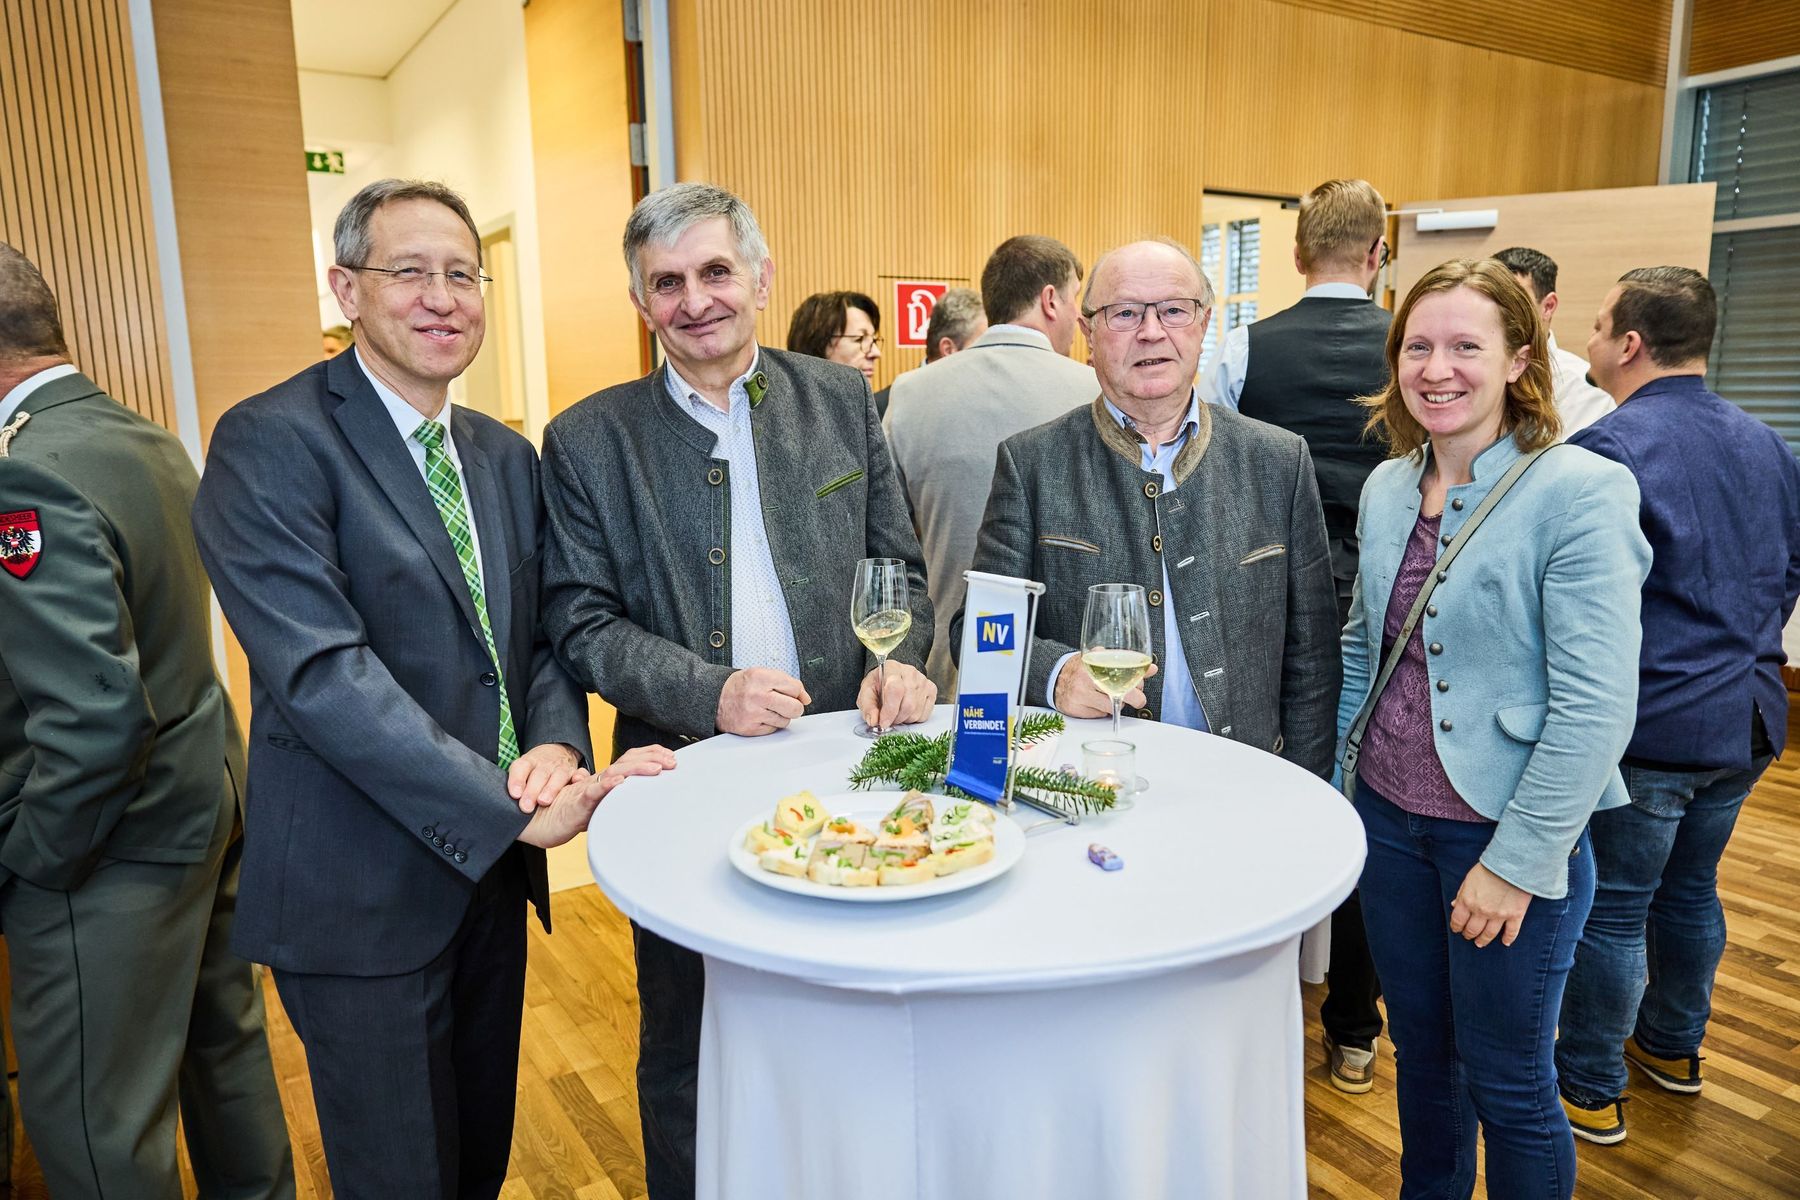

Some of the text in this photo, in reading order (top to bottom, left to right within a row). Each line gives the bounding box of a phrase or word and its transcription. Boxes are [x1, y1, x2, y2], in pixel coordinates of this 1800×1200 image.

[982, 621, 1010, 645] NV
[963, 705, 984, 718] NÄHE
[963, 719, 1006, 731] VERBINDET.
